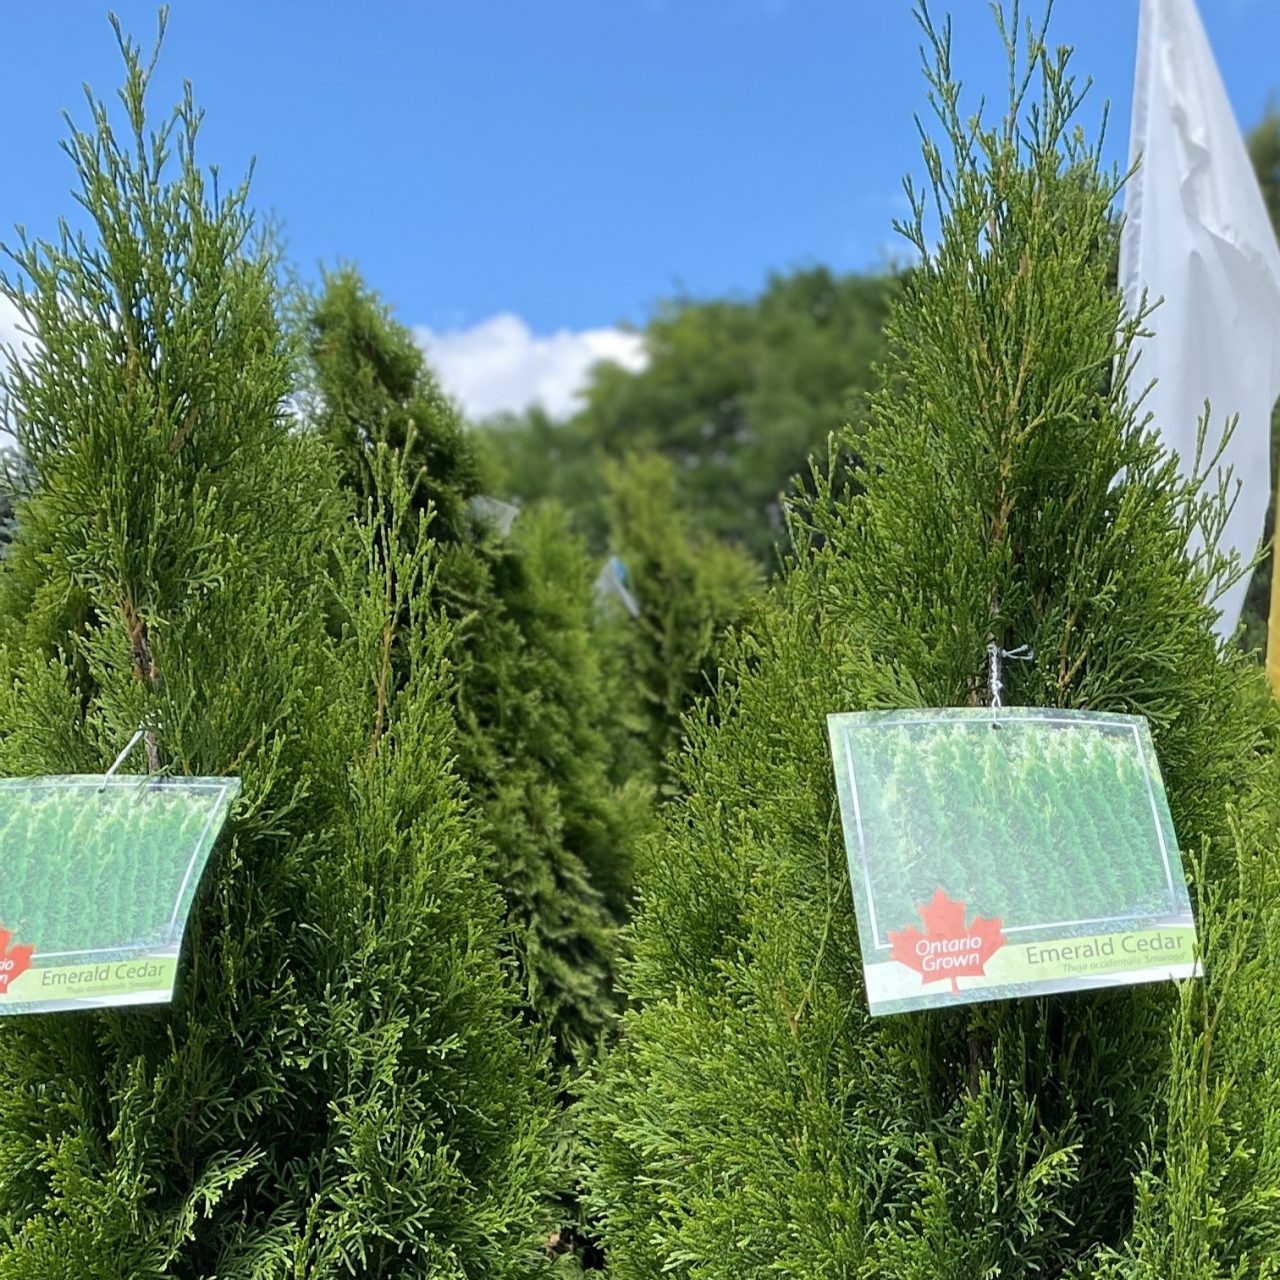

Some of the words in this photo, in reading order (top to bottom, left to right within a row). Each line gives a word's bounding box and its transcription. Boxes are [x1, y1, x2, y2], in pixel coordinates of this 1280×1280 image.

[915, 934, 982, 956] Ontario
[1026, 937, 1115, 964] Emerald
[1121, 932, 1184, 953] Cedar
[41, 965, 110, 986] Emerald
[115, 962, 165, 980] Cedar
[922, 953, 980, 972] Grown
